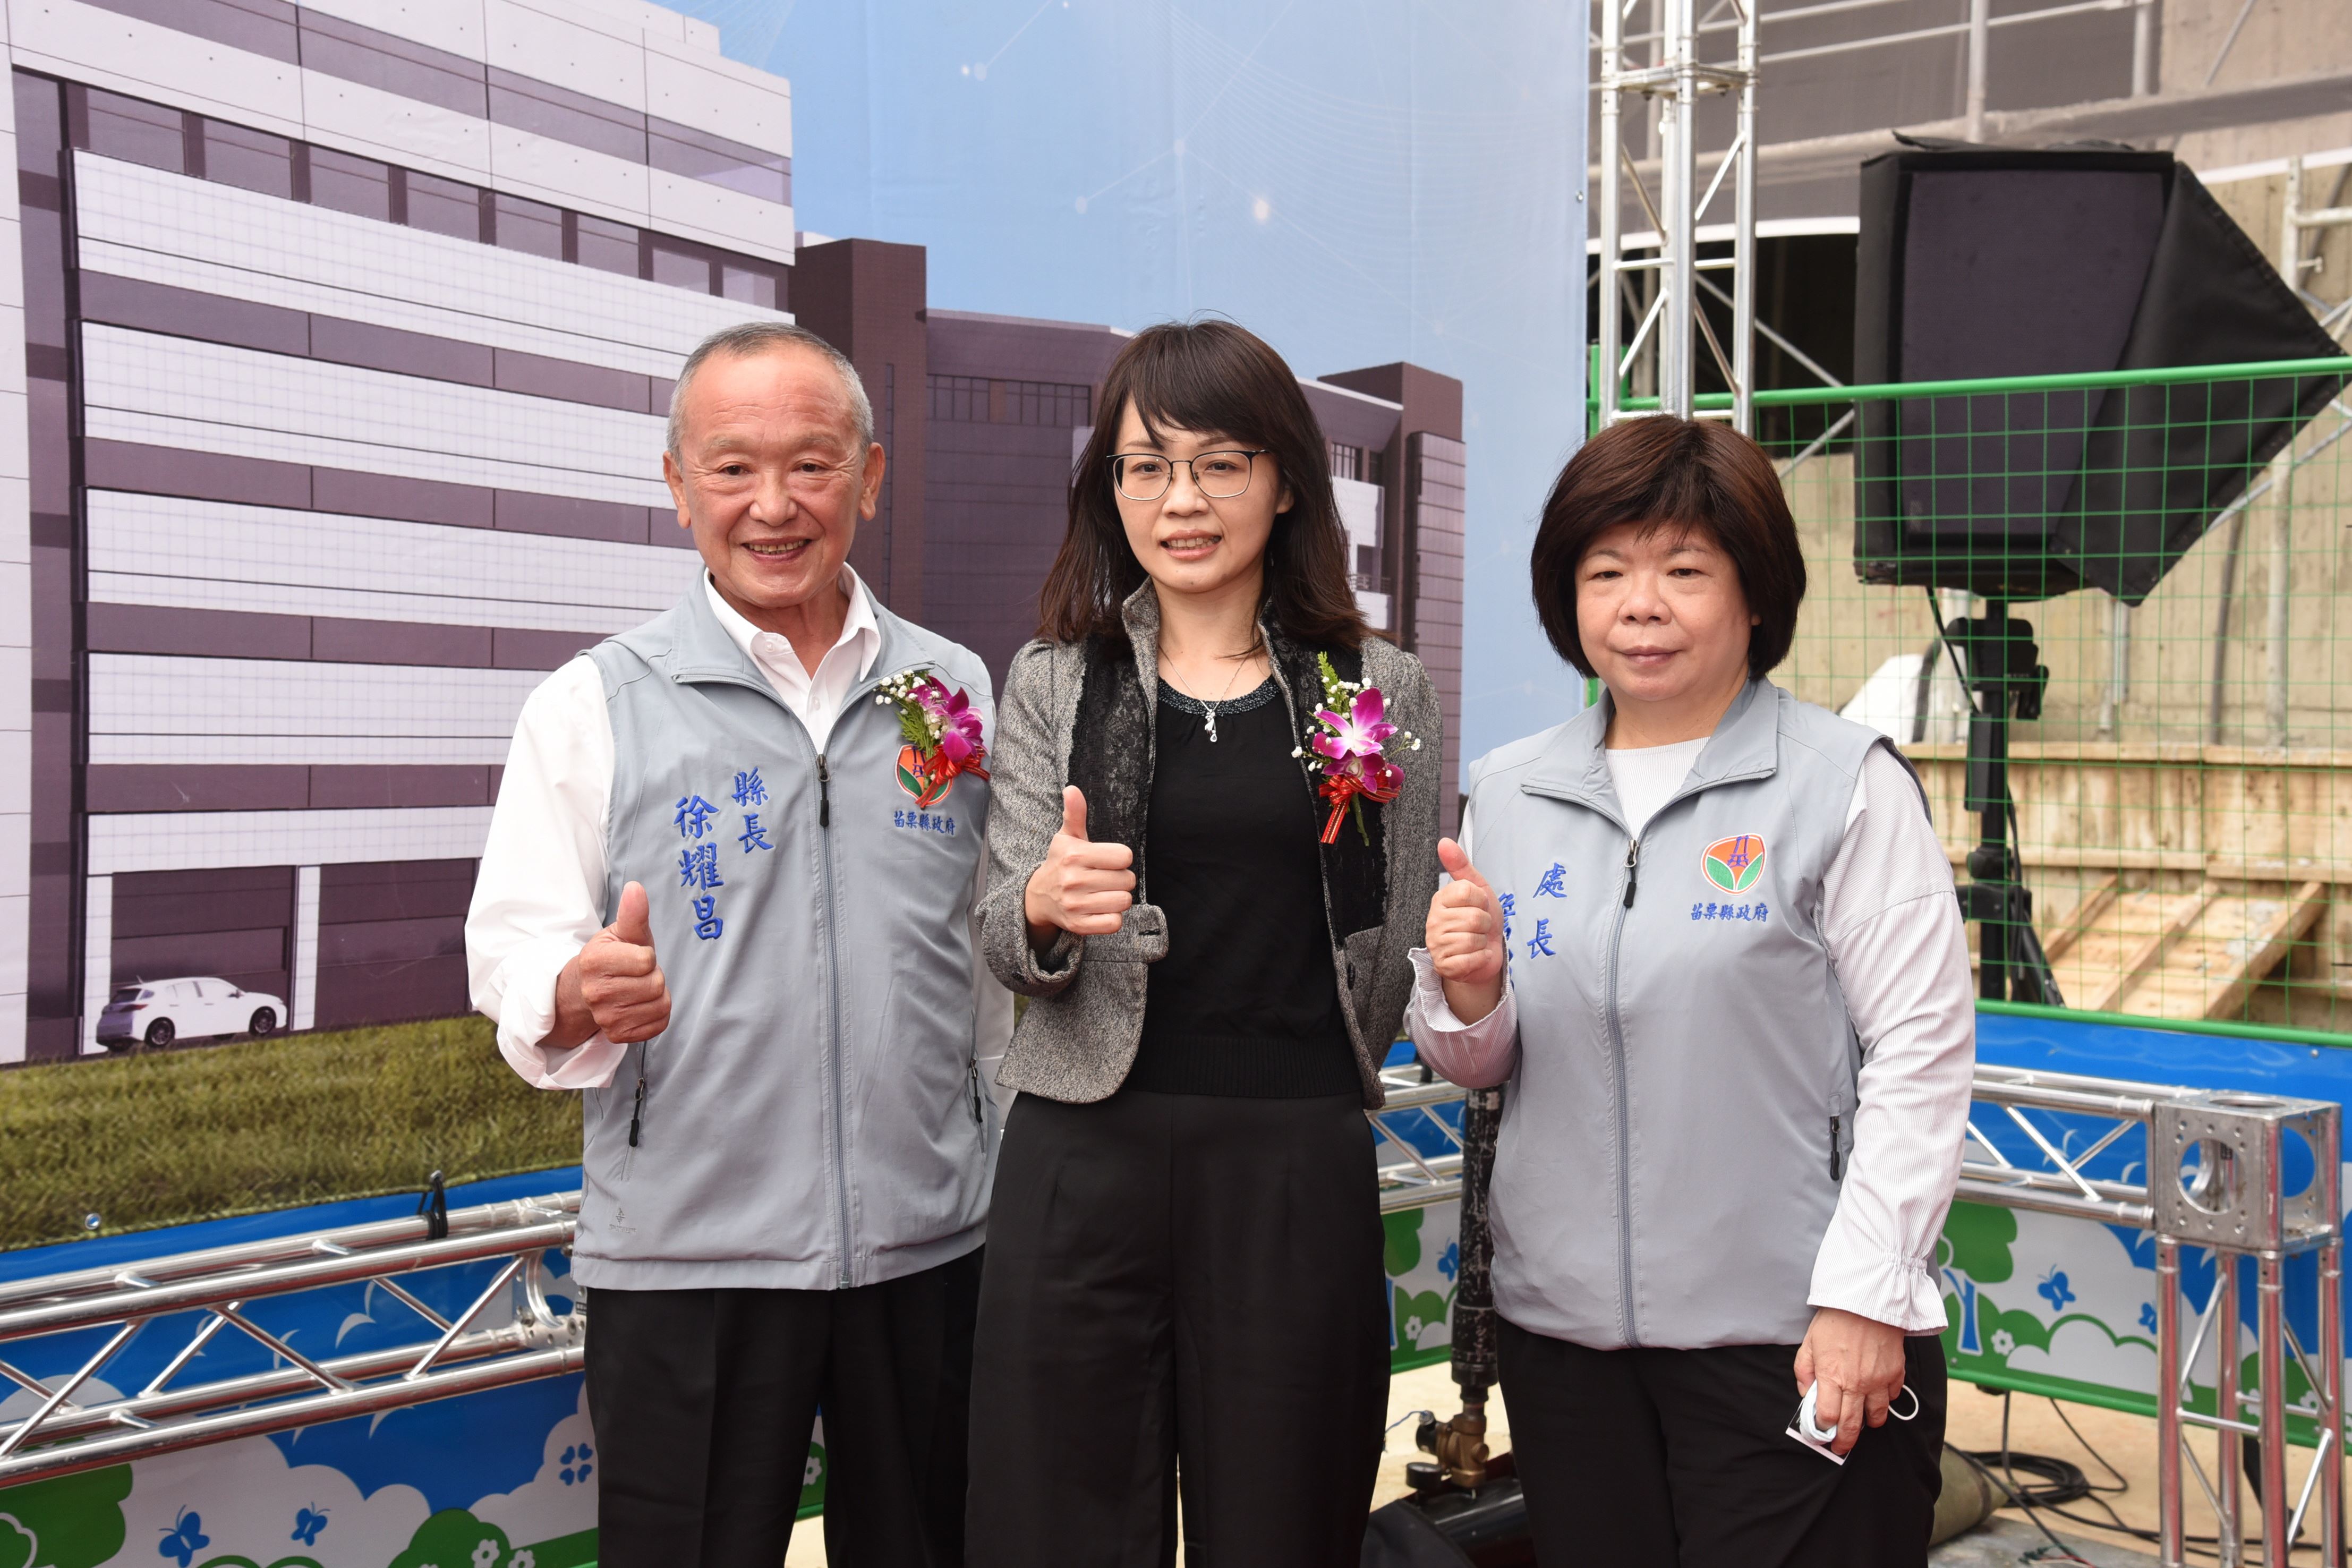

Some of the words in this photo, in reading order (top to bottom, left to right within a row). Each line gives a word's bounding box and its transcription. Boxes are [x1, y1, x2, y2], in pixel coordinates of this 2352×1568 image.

[731, 767, 773, 853] 縣長
[894, 811, 956, 836] 苗栗縣政府
[674, 795, 725, 939] 徐耀昌
[1527, 863, 1567, 958] 處長
[1691, 902, 1768, 922] 苗栗縣政府
